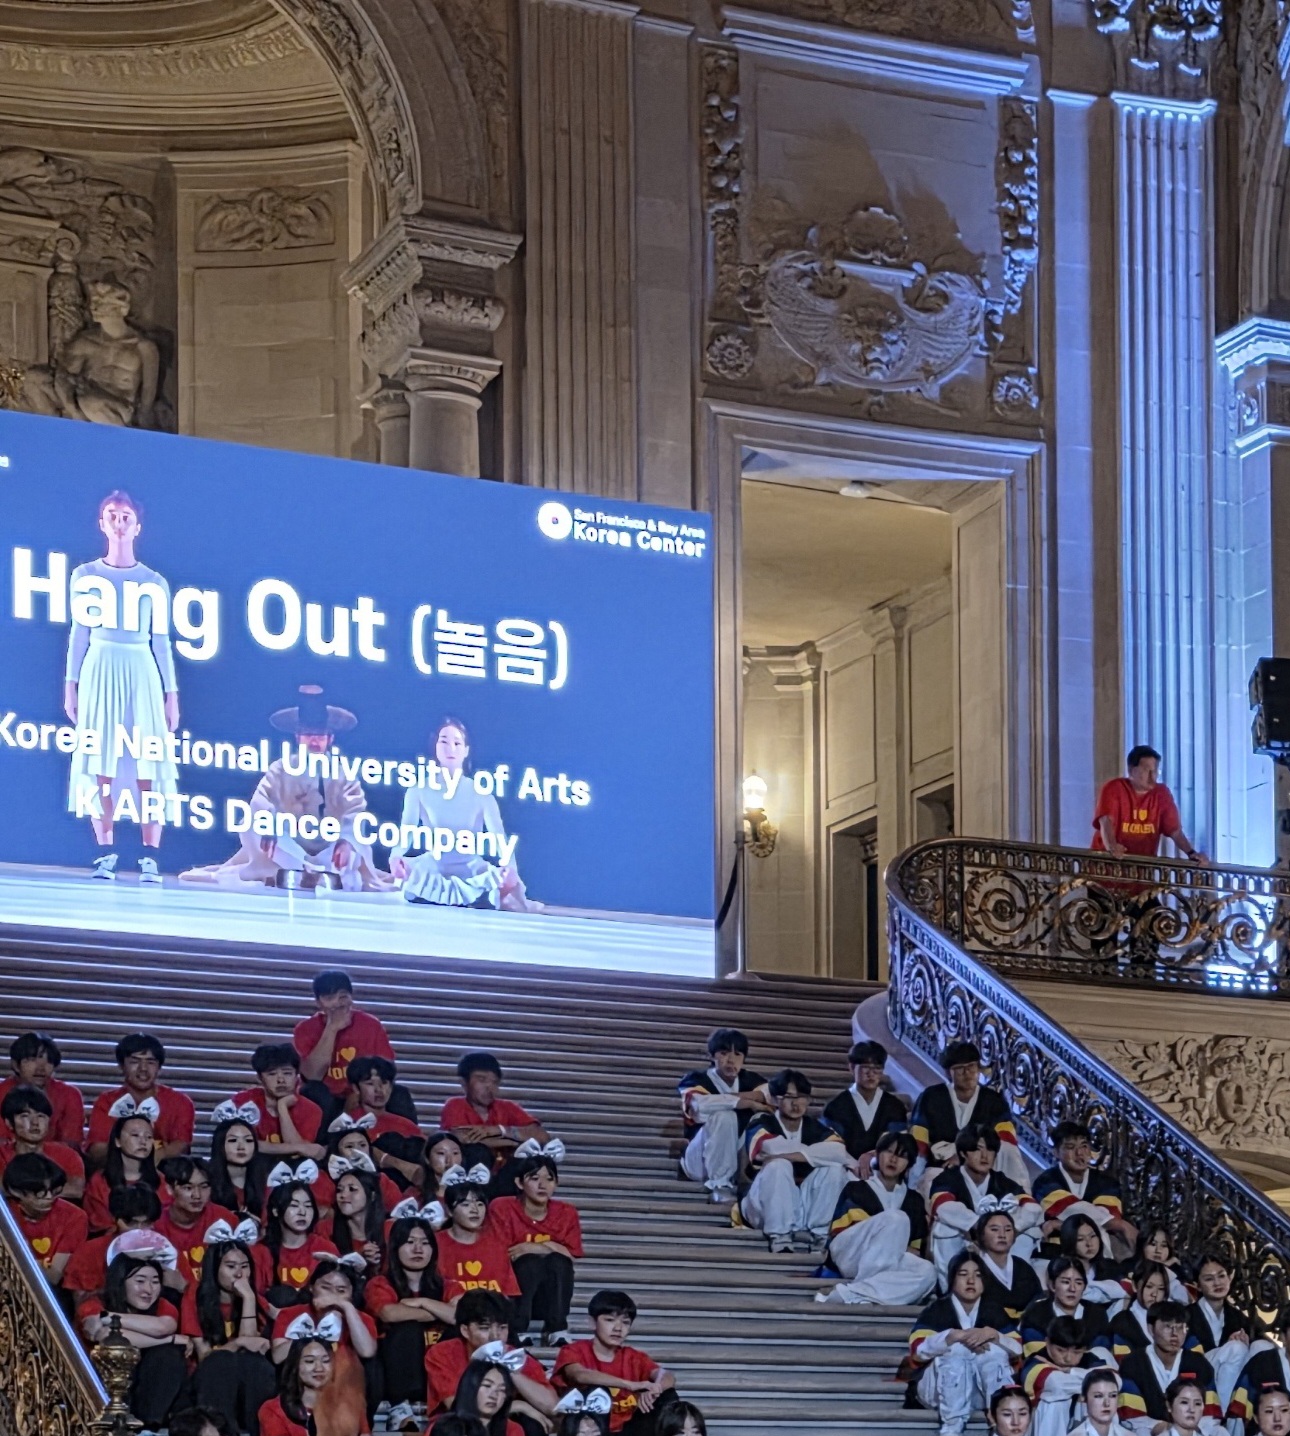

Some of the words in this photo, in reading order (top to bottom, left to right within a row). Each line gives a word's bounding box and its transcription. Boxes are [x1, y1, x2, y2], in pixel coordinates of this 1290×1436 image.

[573, 520, 632, 548] Korea
[636, 529, 706, 558] Center
[13, 546, 220, 662] Hang
[246, 577, 386, 663] Out
[410, 603, 569, 690] (놀음)
[114, 723, 270, 773] National
[281, 740, 464, 800] University
[473, 763, 511, 798] of
[518, 766, 592, 807] Arts
[225, 797, 341, 843] Dance
[352, 811, 519, 867] Company
